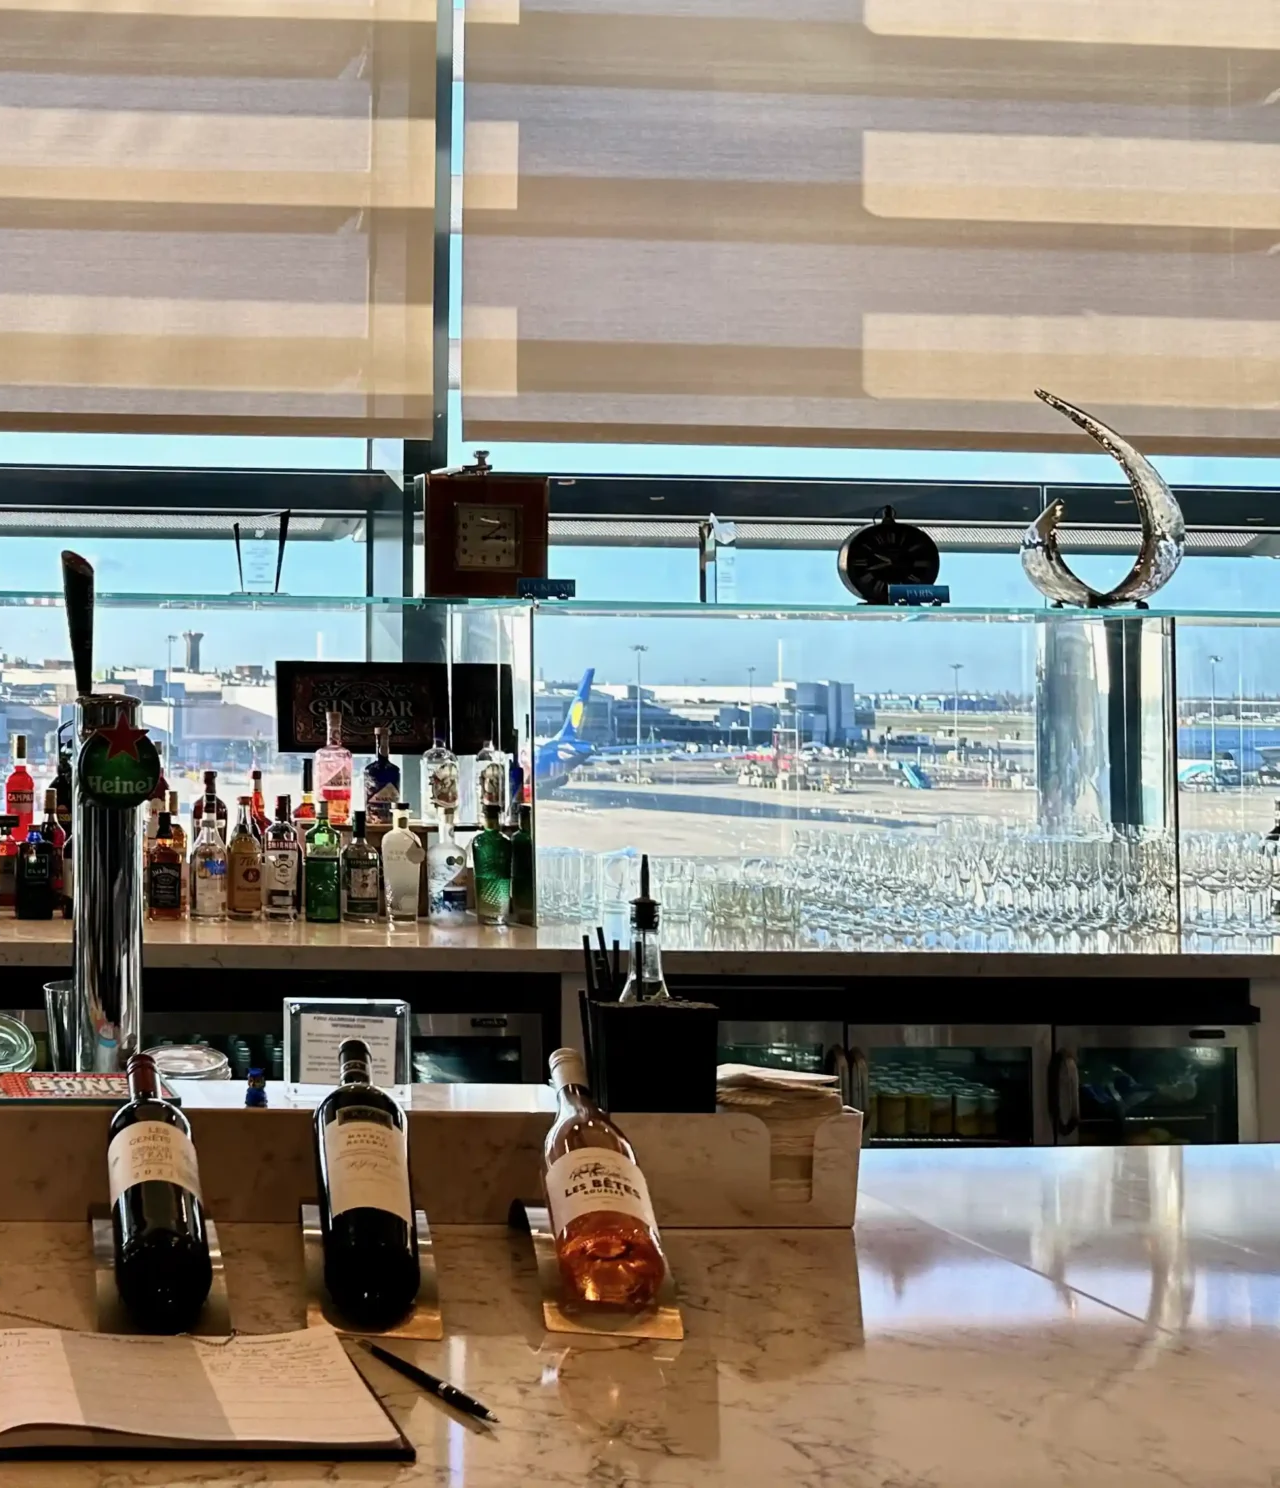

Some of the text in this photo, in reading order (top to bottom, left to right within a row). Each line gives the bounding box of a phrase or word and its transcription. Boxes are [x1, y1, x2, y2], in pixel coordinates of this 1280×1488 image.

[906, 589, 934, 598] PARIS
[309, 699, 414, 717] GIN BAR
[148, 1127, 170, 1136] LES
[565, 1183, 587, 1198] LES
